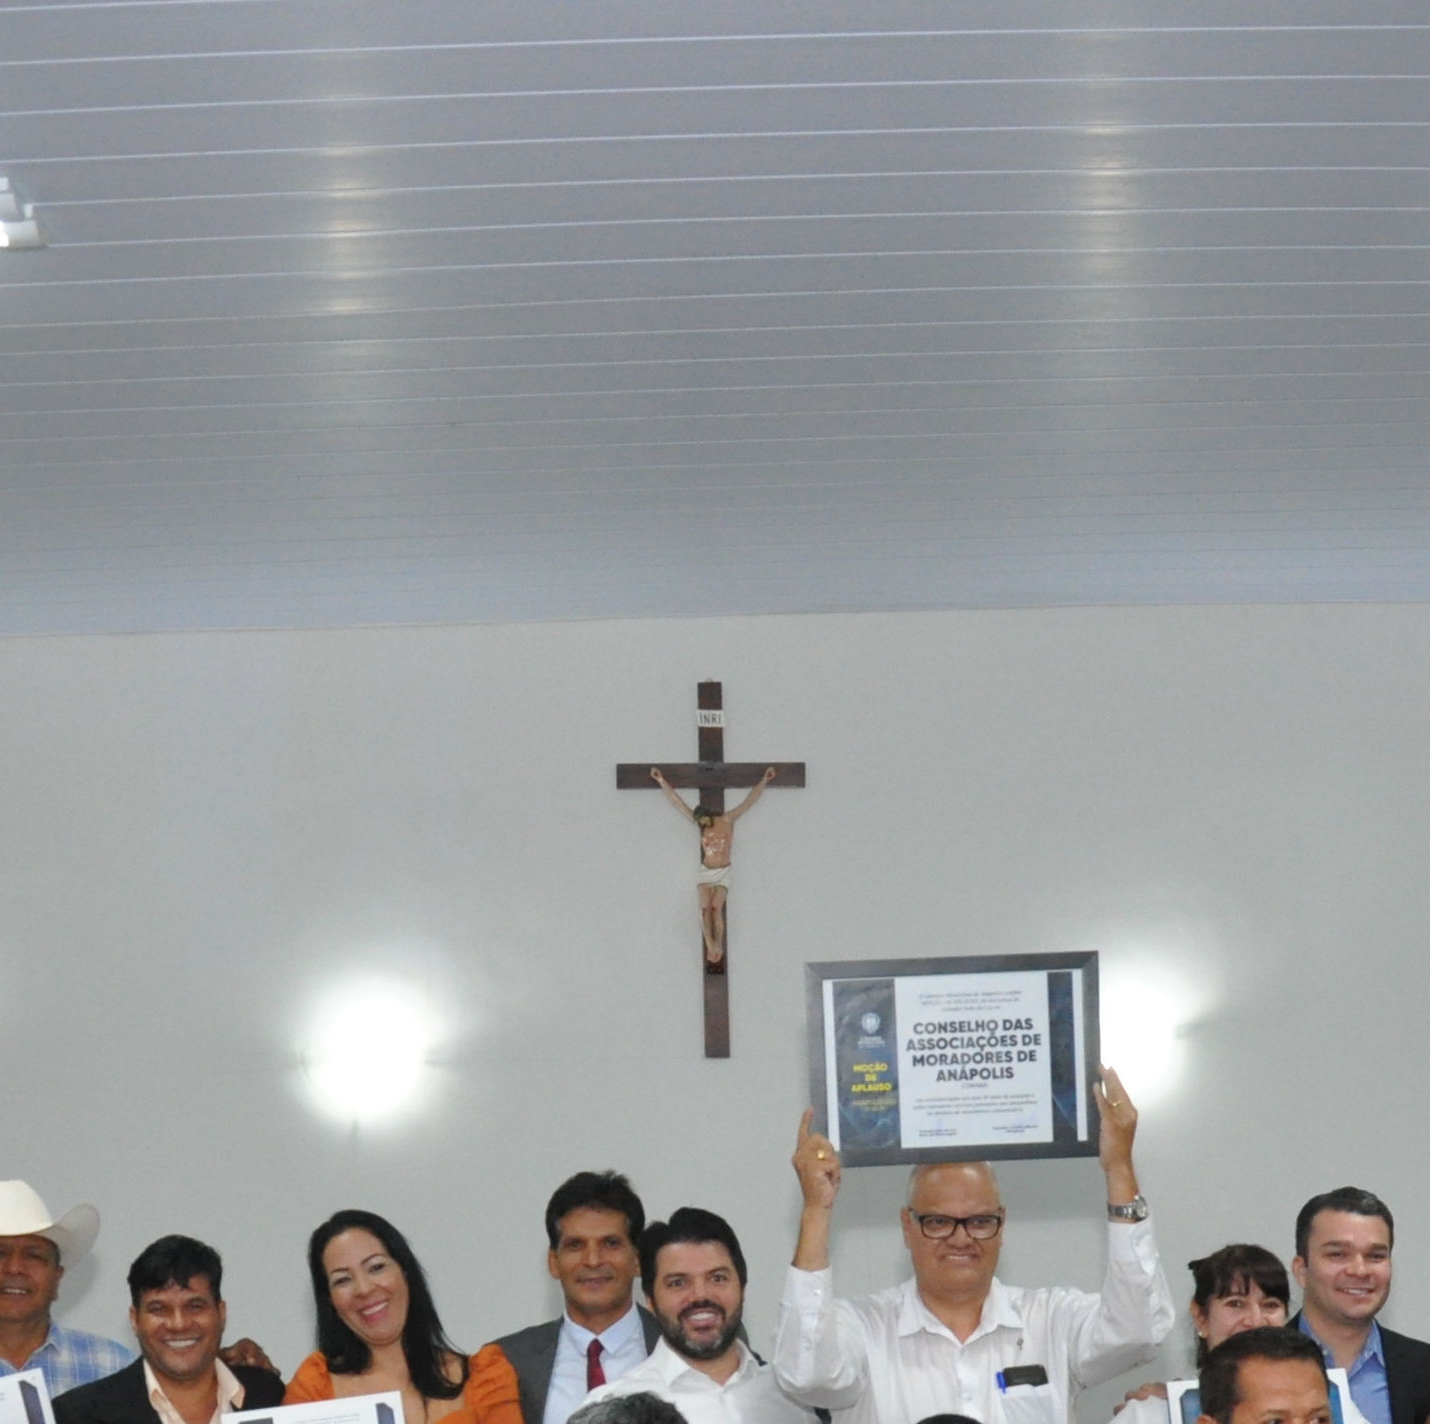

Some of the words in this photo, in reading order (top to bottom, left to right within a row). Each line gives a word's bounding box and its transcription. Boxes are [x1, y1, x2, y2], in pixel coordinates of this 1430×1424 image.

[699, 713, 722, 724] INRI
[914, 1020, 998, 1034] CONSELHO
[1003, 1018, 1033, 1031] DAS
[907, 1032, 1018, 1052] ASSOCIAÇÕES
[1022, 1034, 1041, 1046] DE
[913, 1051, 1013, 1067] MORADORES
[1017, 1050, 1036, 1062] DE
[937, 1063, 1014, 1081] ANÁPOLIS
